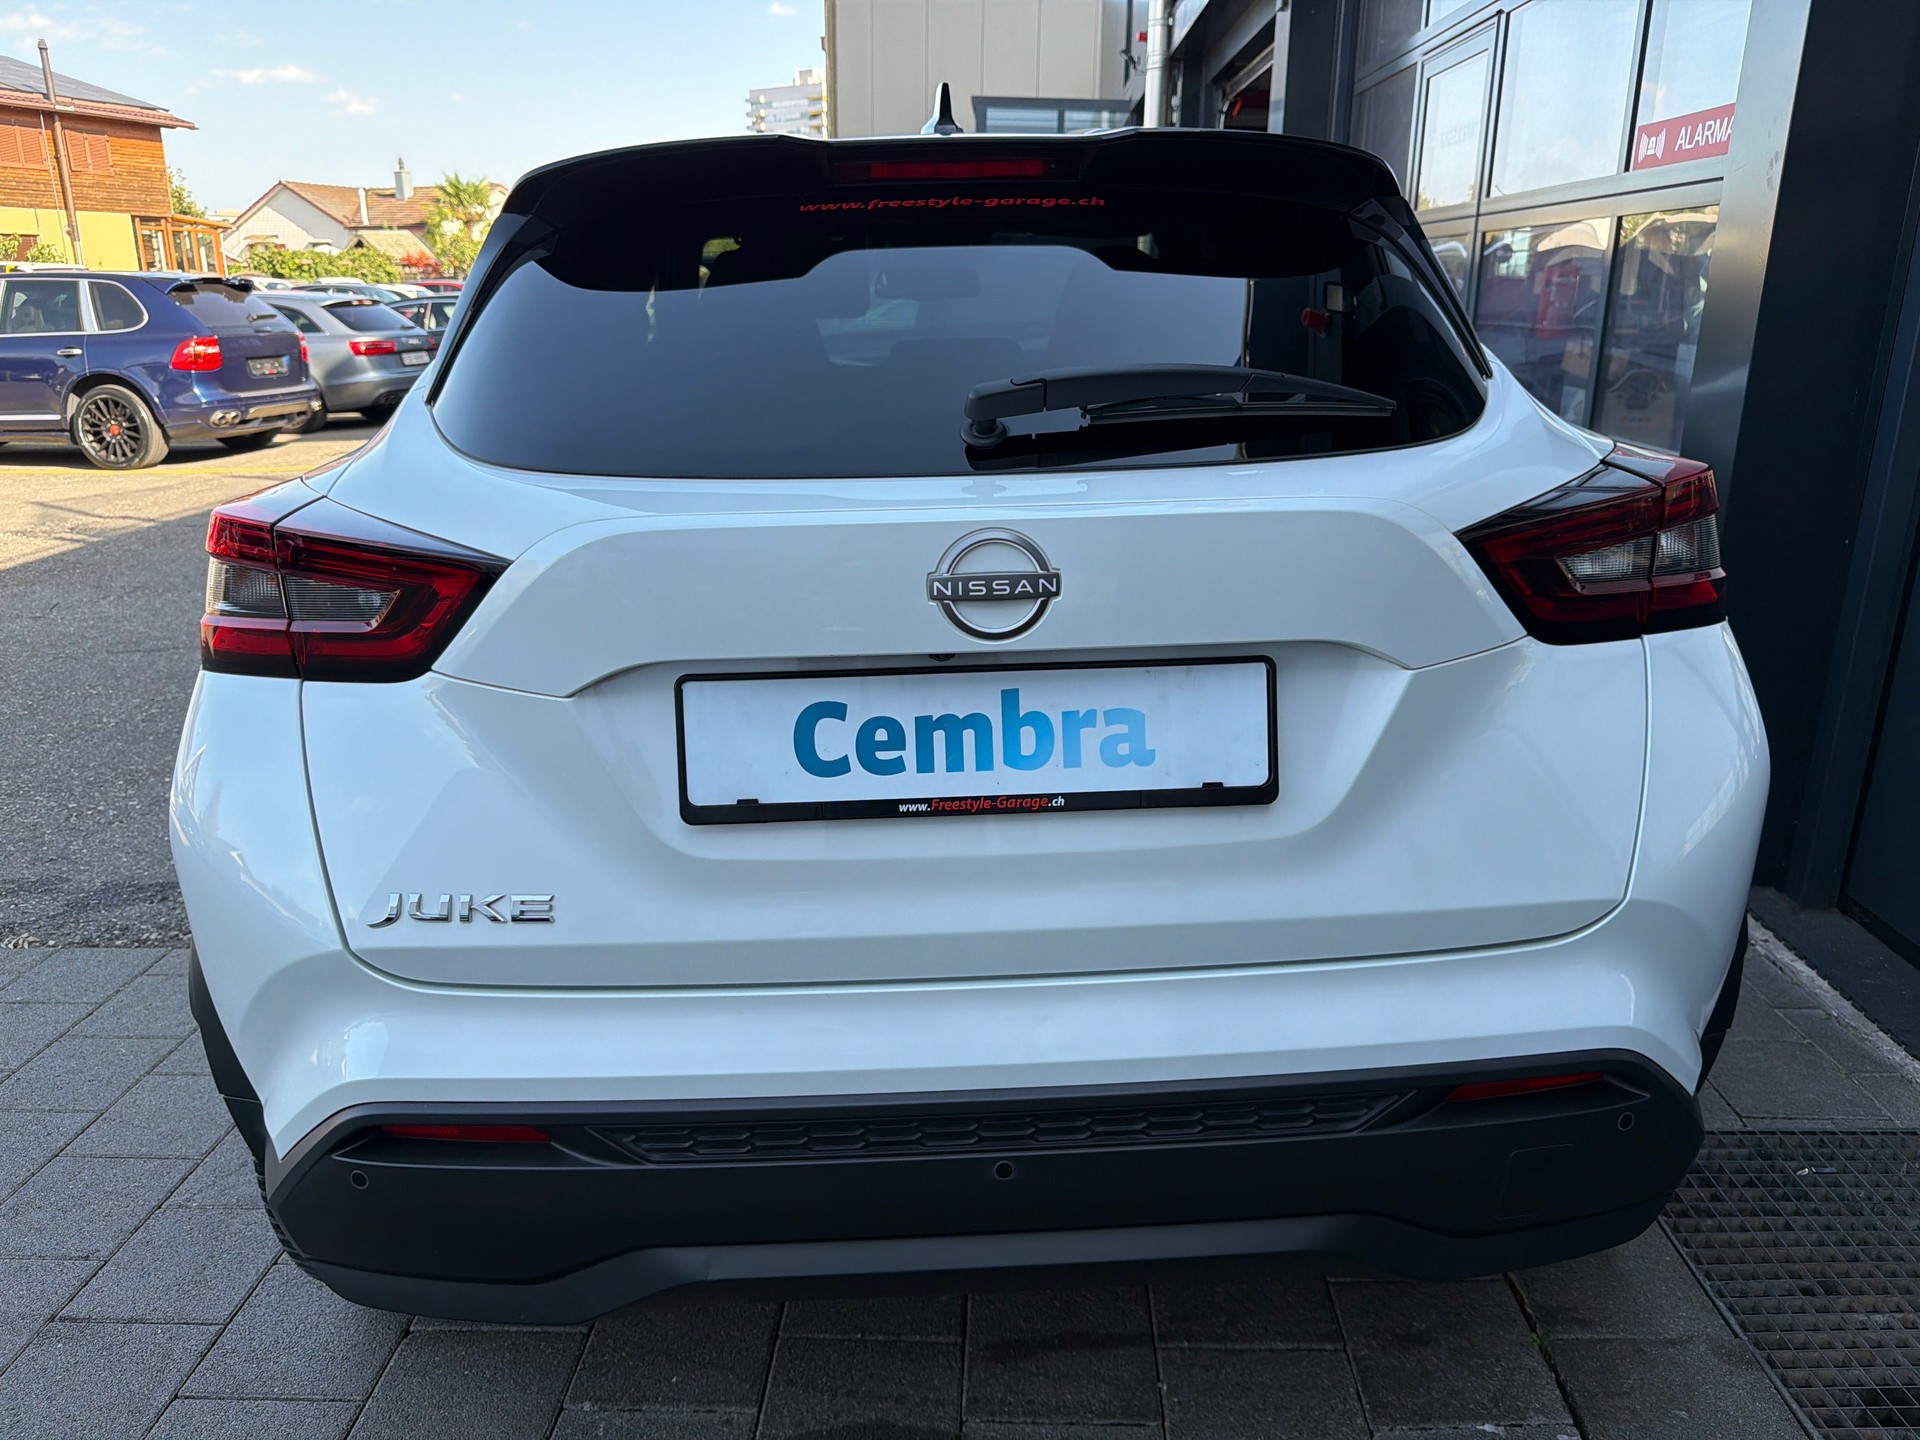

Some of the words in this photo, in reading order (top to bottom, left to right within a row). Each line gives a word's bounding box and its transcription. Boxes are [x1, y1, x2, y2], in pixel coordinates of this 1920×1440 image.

[799, 196, 1106, 212] www.freestyle-garage.ch
[933, 577, 1057, 596] NISSAN
[793, 687, 1156, 778] Cembra
[898, 795, 1066, 814] www.Freestyle-Garage.ch
[366, 892, 556, 929] JUKE
